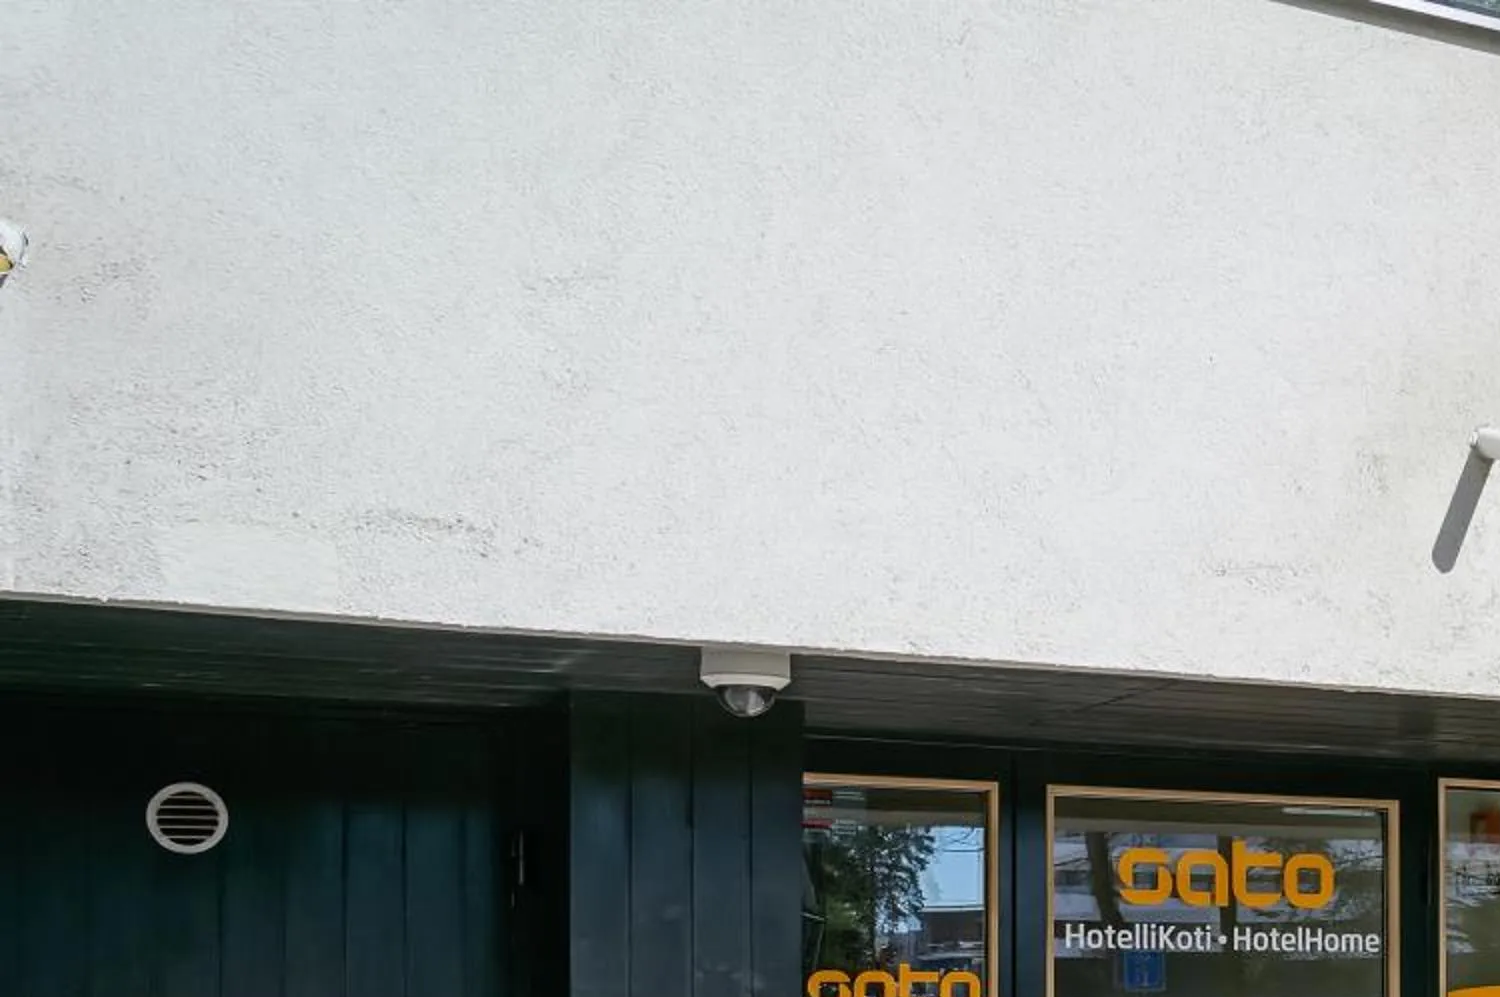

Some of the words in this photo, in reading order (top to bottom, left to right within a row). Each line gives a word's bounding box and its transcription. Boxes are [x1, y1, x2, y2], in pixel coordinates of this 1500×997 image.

[1119, 838, 1336, 910] sato
[1065, 923, 1212, 950] HotelliKoti
[1233, 927, 1380, 953] HotelHome
